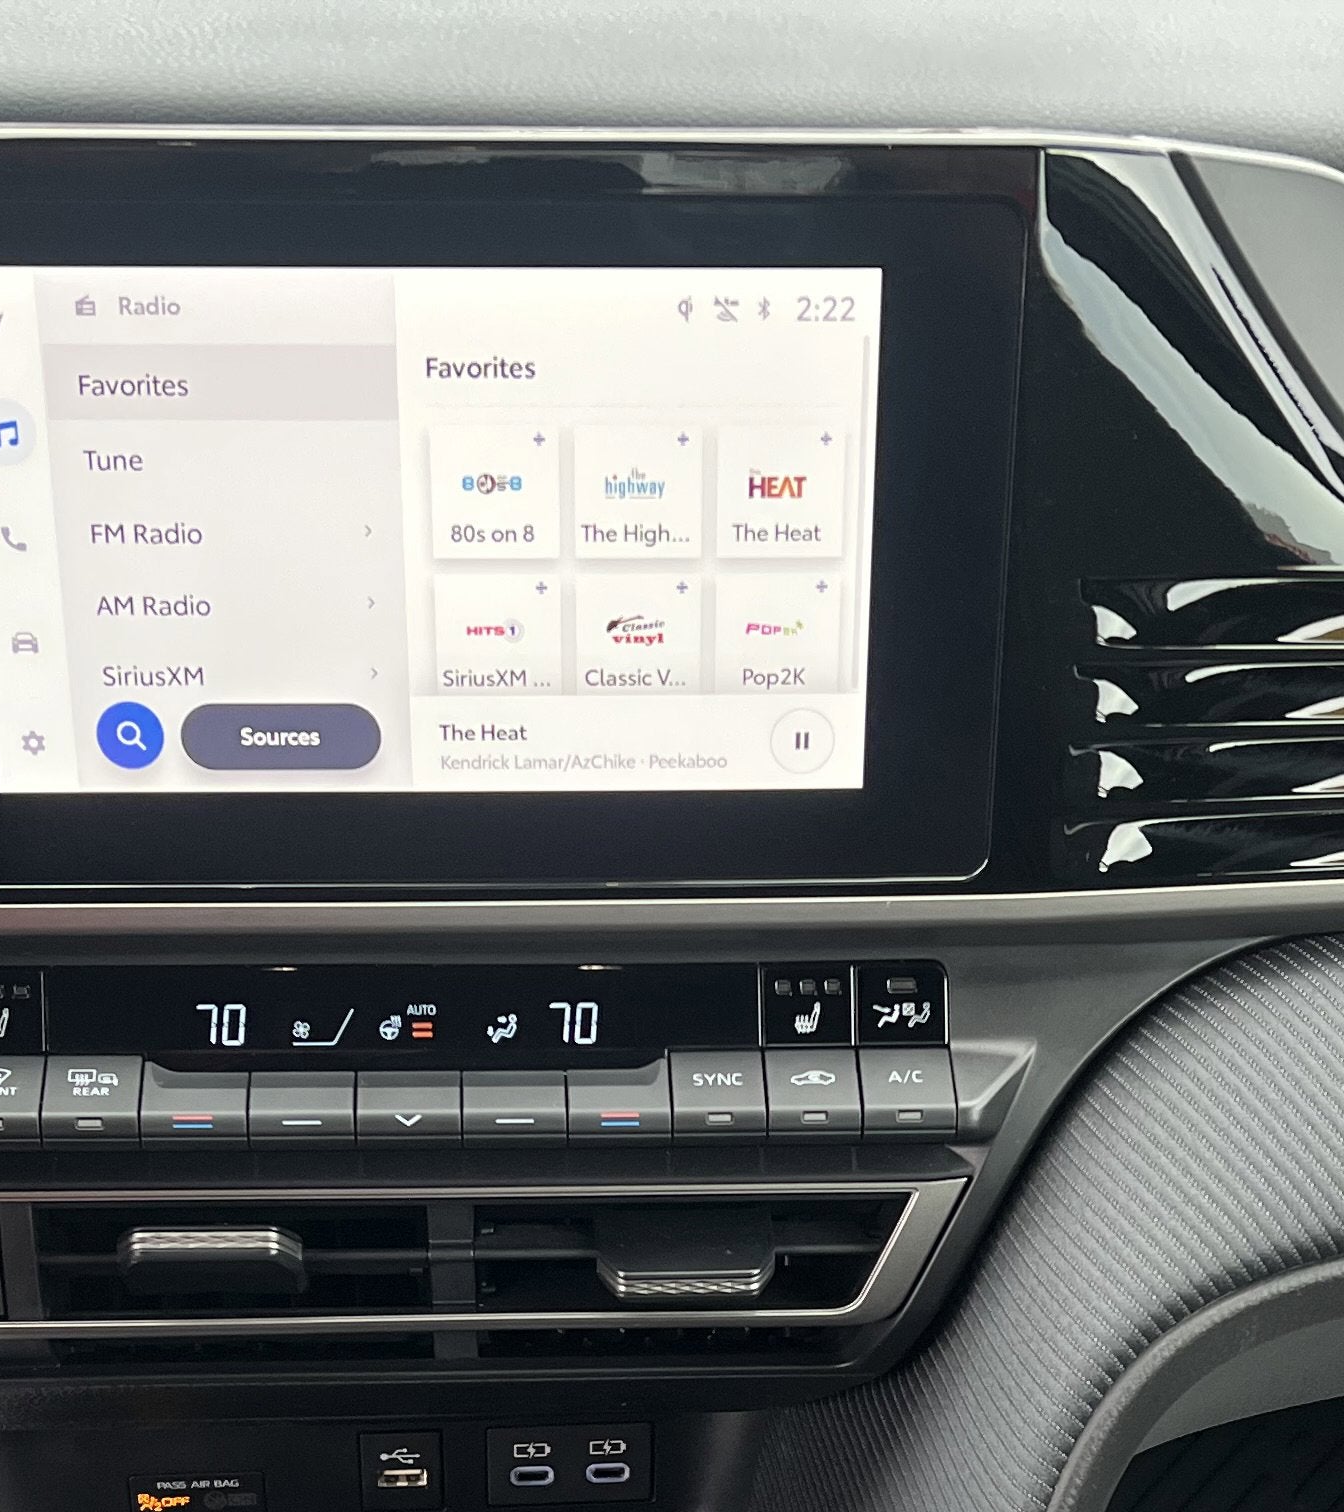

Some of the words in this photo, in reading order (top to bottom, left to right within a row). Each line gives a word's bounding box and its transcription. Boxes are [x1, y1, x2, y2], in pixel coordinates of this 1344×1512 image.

[118, 295, 181, 316] Radio
[796, 295, 855, 322] 2:22
[426, 356, 536, 380] Favorites
[78, 373, 189, 397] Favorites
[82, 450, 144, 472] Tune
[604, 474, 666, 499] highway
[748, 476, 807, 498] HEAT
[90, 523, 125, 544] FM
[133, 522, 203, 545] Radio
[450, 524, 486, 543] 80s
[491, 529, 517, 543] on
[522, 524, 535, 543] 8
[580, 524, 618, 543] The
[732, 522, 769, 542] The
[774, 523, 821, 542] Heat
[96, 596, 135, 616] AM
[142, 594, 211, 617] Radio
[102, 665, 204, 687] SiriusXM
[442, 669, 527, 688] SiriusXM
[584, 668, 652, 687] Classic
[742, 667, 806, 691] Pop2K
[240, 728, 321, 747] Sources
[439, 723, 476, 741] The
[481, 724, 528, 741] Heat
[440, 753, 510, 770] Kendrick
[514, 753, 636, 772] Lamar/AzChike
[648, 752, 728, 769] Peekaboo
[407, 1005, 436, 1016] AUTO
[196, 1003, 246, 1047] 70
[550, 1002, 598, 1045] 70
[692, 1072, 743, 1087] SYNC
[888, 1069, 924, 1084] A/C
[73, 1086, 110, 1097] REAR
[156, 1481, 187, 1490] PASS
[191, 1480, 211, 1489] AIR
[213, 1479, 240, 1488] BAG
